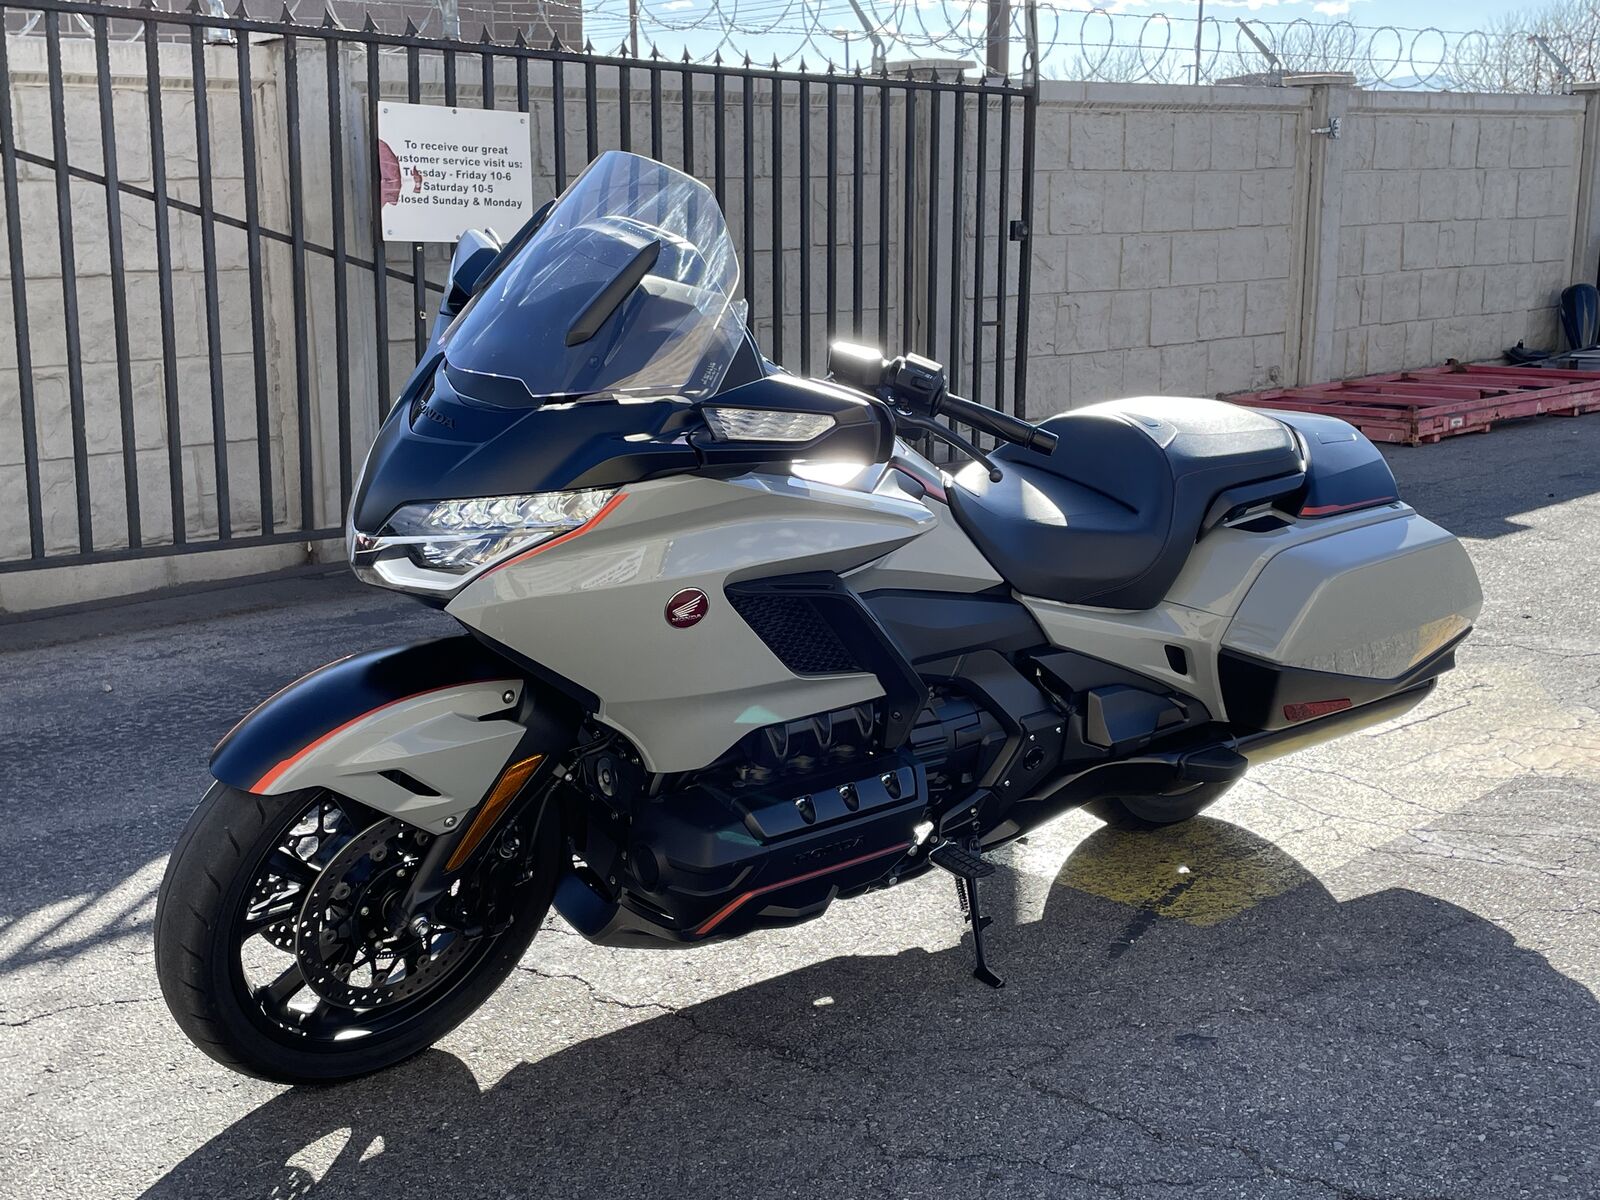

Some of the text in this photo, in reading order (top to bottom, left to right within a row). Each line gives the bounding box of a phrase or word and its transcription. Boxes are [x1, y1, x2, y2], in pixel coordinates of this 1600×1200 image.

[404, 140, 509, 156] To receive our great
[397, 154, 523, 169] ustomer service visit us:
[456, 170, 487, 182] Friday
[490, 171, 512, 181] 10-6
[423, 182, 494, 195] Saturday 10-5
[400, 195, 523, 210] losed Sunday & Monday
